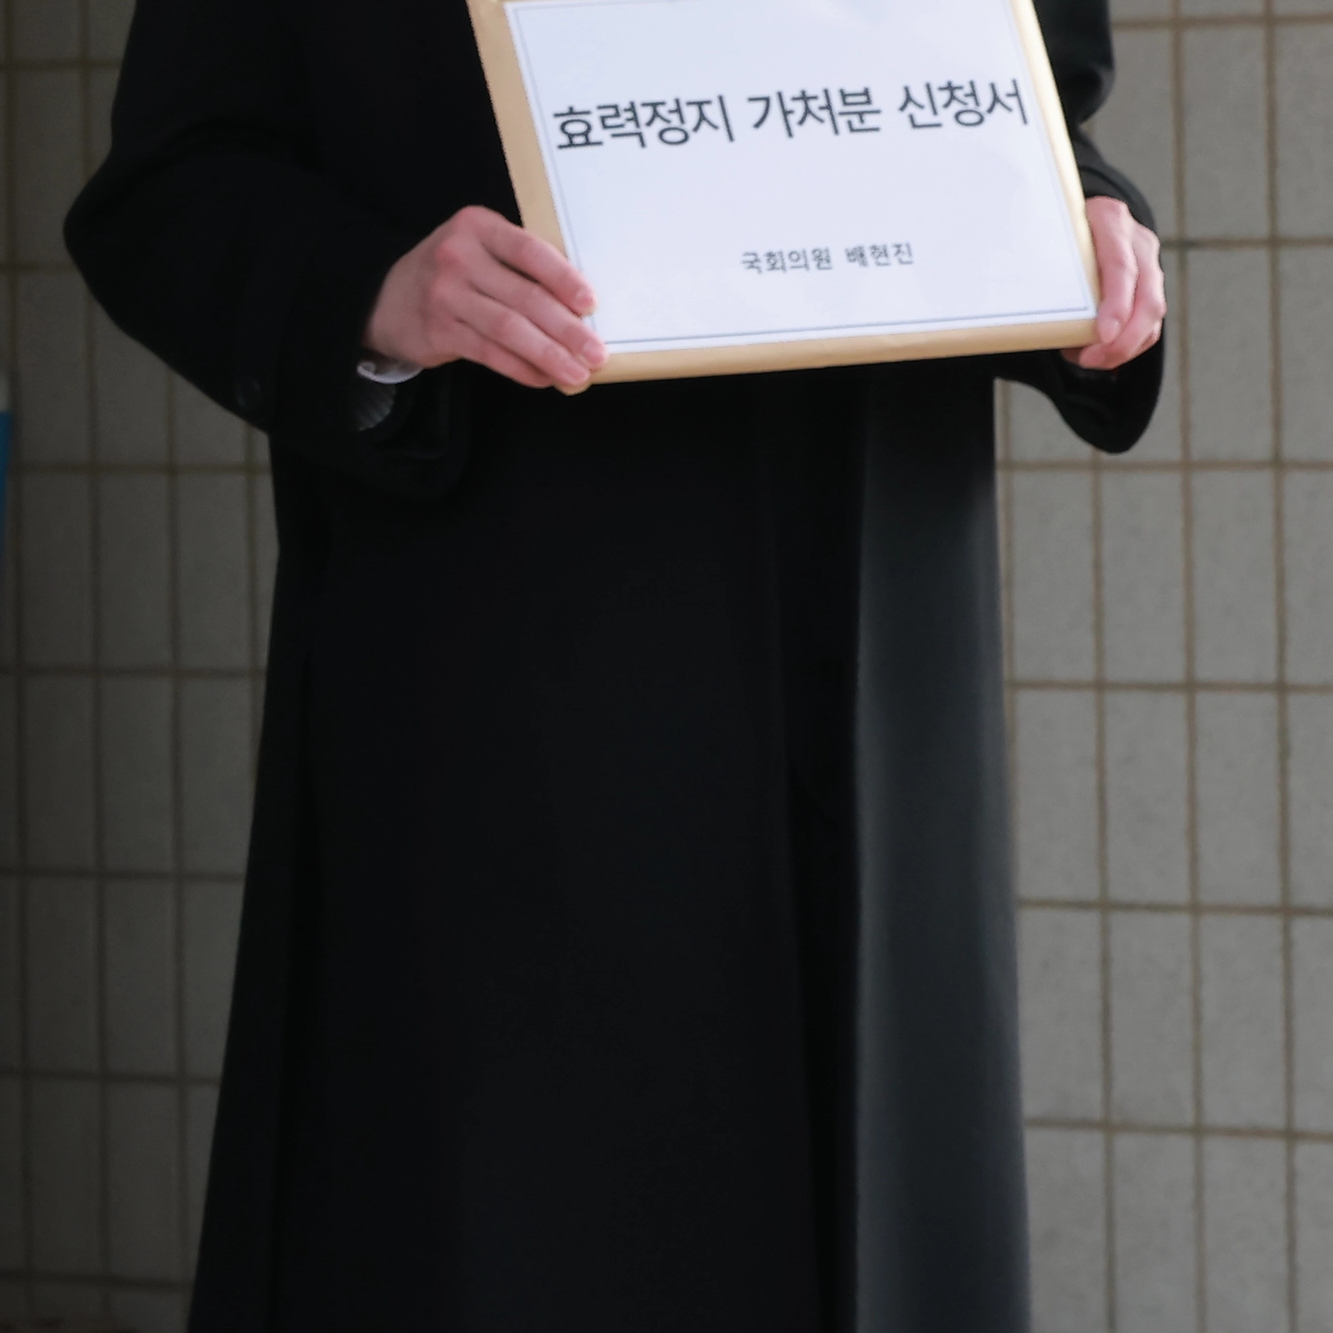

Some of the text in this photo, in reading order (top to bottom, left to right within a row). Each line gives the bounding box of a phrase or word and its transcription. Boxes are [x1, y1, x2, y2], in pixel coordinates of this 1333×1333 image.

[553, 78, 1028, 149] 효력정지 가처분 신청서
[741, 242, 913, 274] 국회의원 배현진
